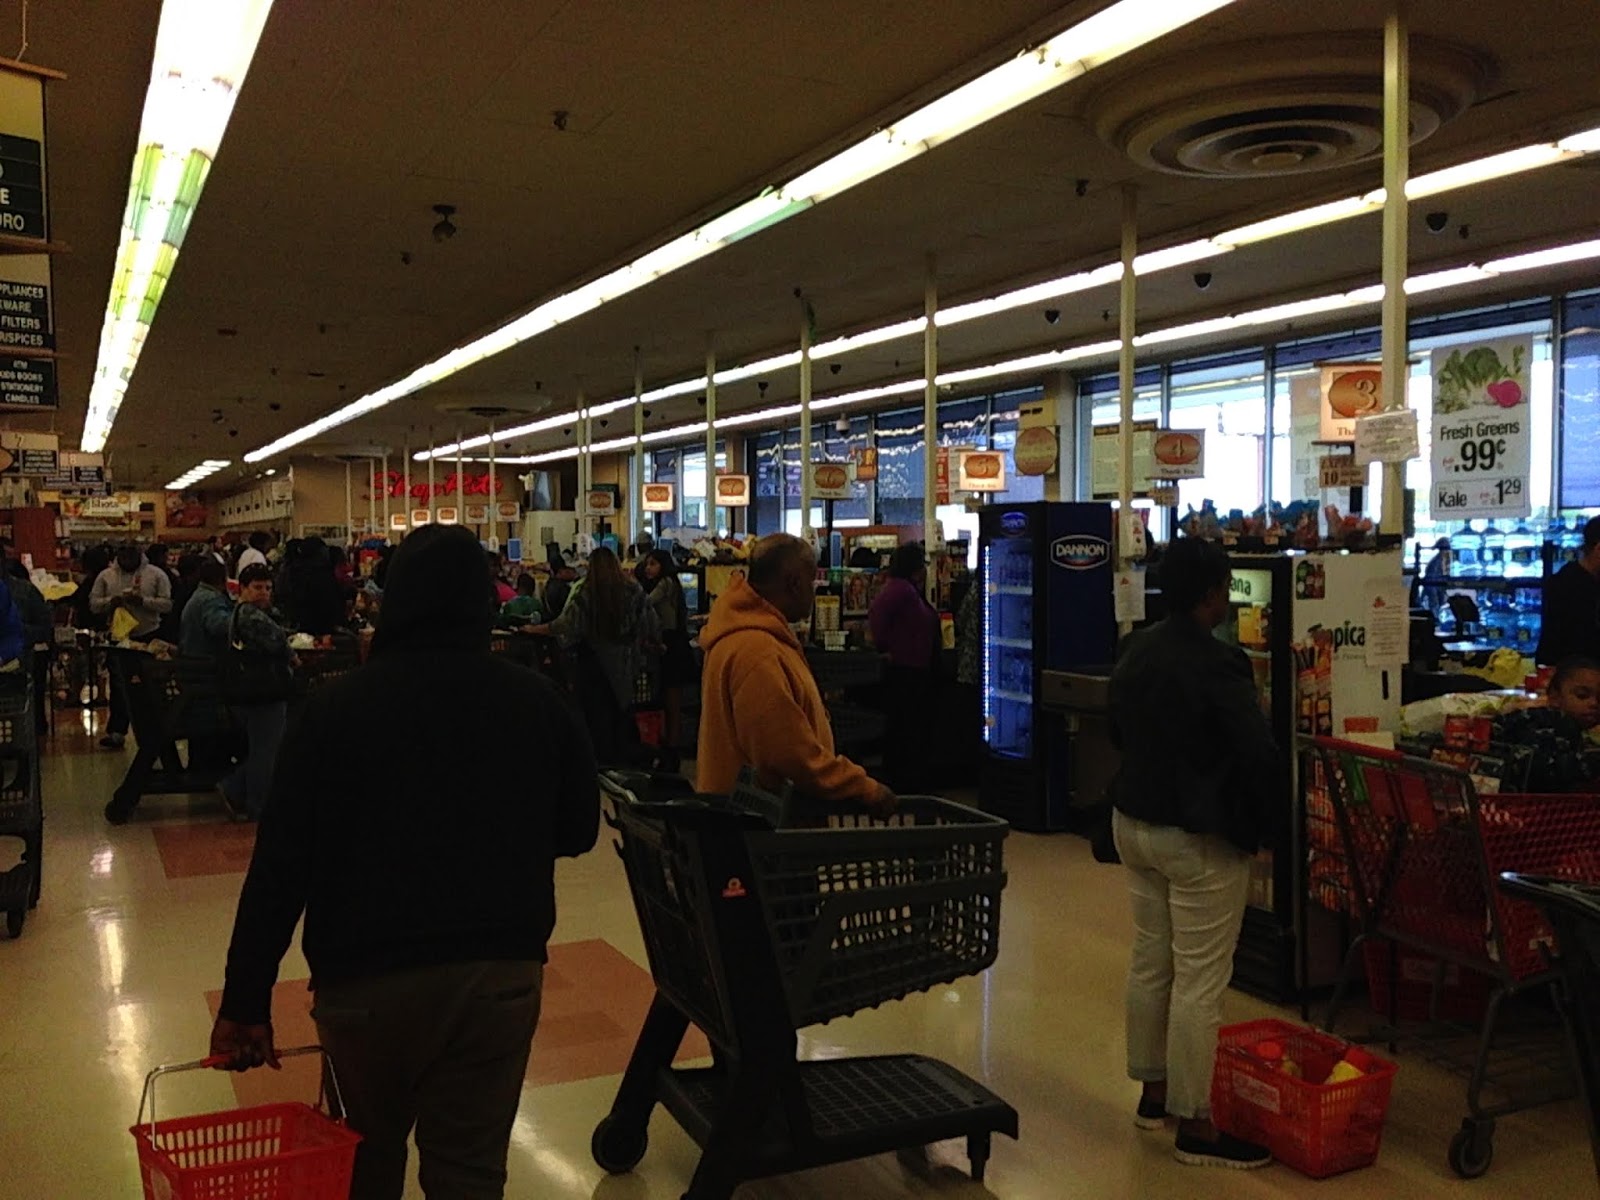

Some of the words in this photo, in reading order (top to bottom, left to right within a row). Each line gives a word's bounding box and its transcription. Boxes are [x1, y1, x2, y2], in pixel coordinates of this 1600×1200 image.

[1, 315, 42, 330] FILTERS
[1356, 379, 1378, 411] 3
[1440, 424, 1473, 441] Fresh
[1476, 421, 1520, 437] Greens
[1171, 439, 1185, 456] 4
[977, 457, 991, 475] 5
[1324, 471, 1339, 485] 10
[1438, 490, 1467, 508] Kale
[1055, 542, 1105, 558] DANNON
